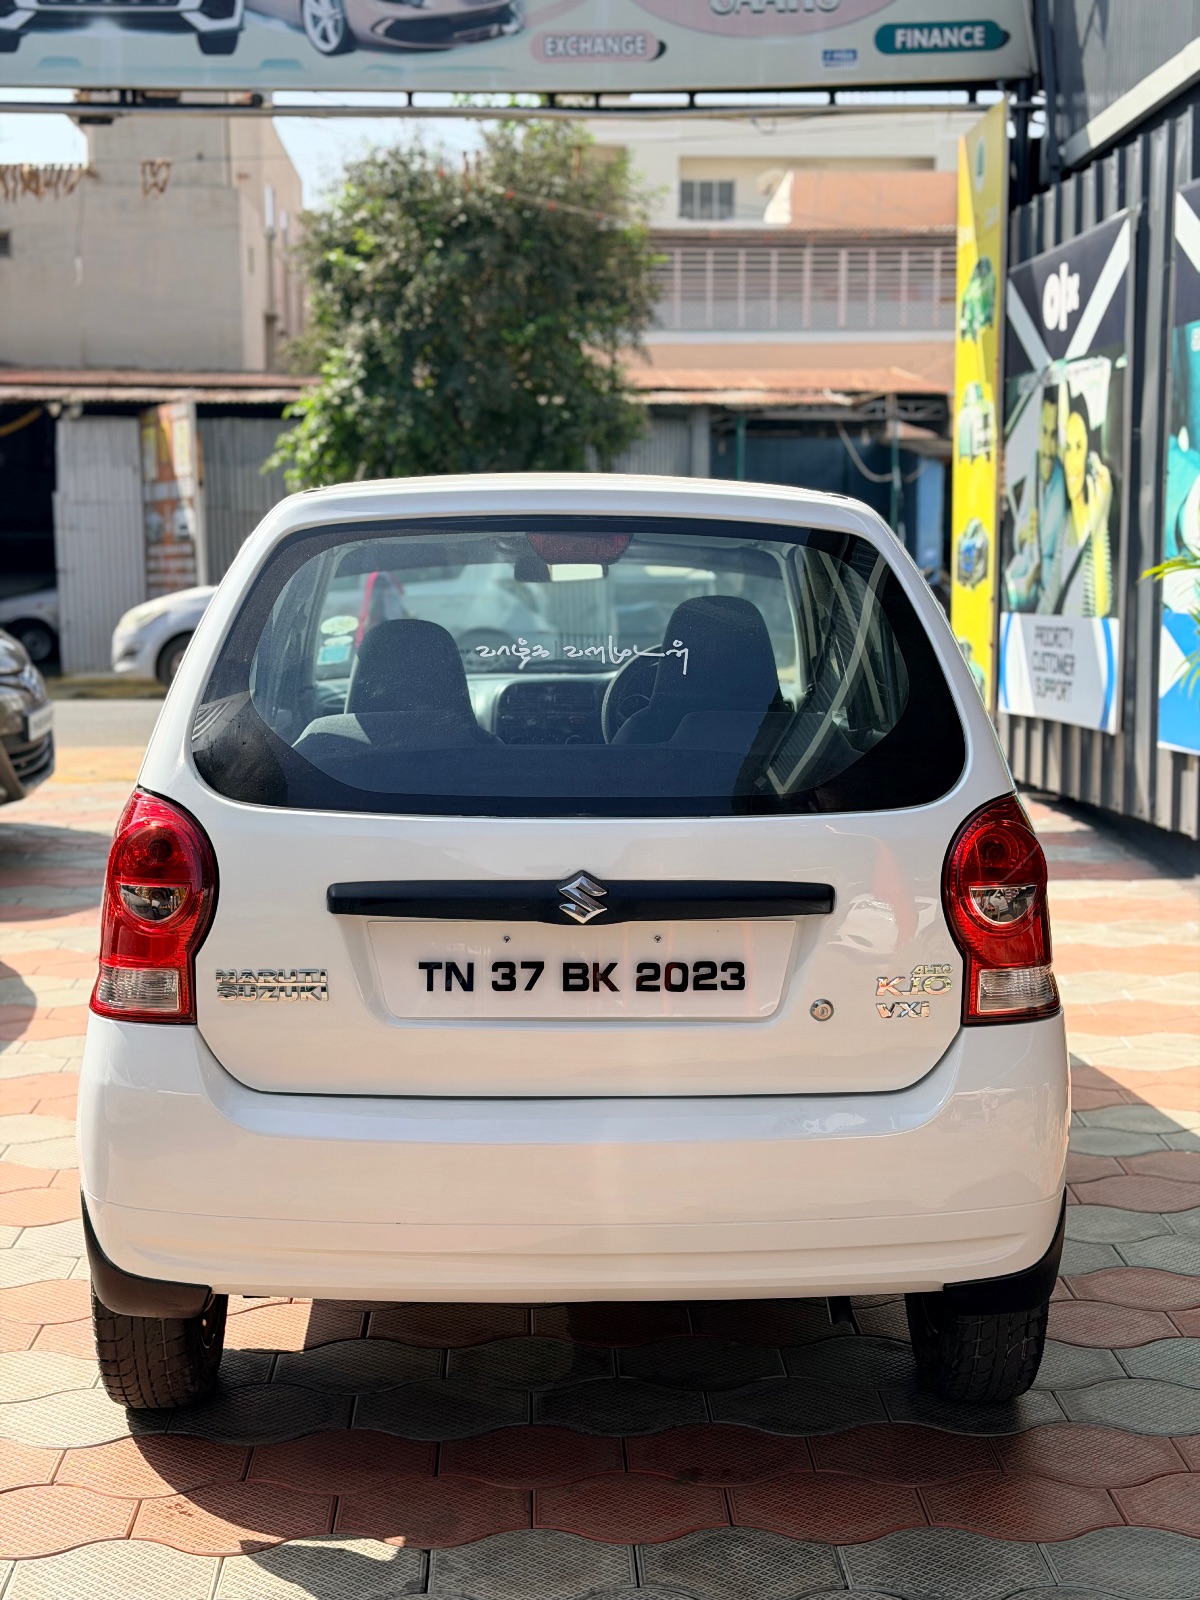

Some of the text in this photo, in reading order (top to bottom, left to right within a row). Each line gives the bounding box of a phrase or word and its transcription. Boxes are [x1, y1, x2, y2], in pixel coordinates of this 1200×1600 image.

[543, 34, 647, 58] EXCHANGE
[894, 24, 986, 50] FINANCE
[1034, 625, 1074, 649] PRIORITY
[475, 637, 550, 670] வாழ்க
[1032, 650, 1076, 677] CUSTOMER
[1034, 677, 1074, 702] SUPPORT
[215, 968, 329, 984] MARUTI
[418, 961, 746, 993] TN 37 BK 2023
[911, 963, 954, 975] ALTO
[216, 984, 330, 1002] SUZUKI
[875, 976, 953, 997] K10
[875, 1001, 931, 1020] VXi
